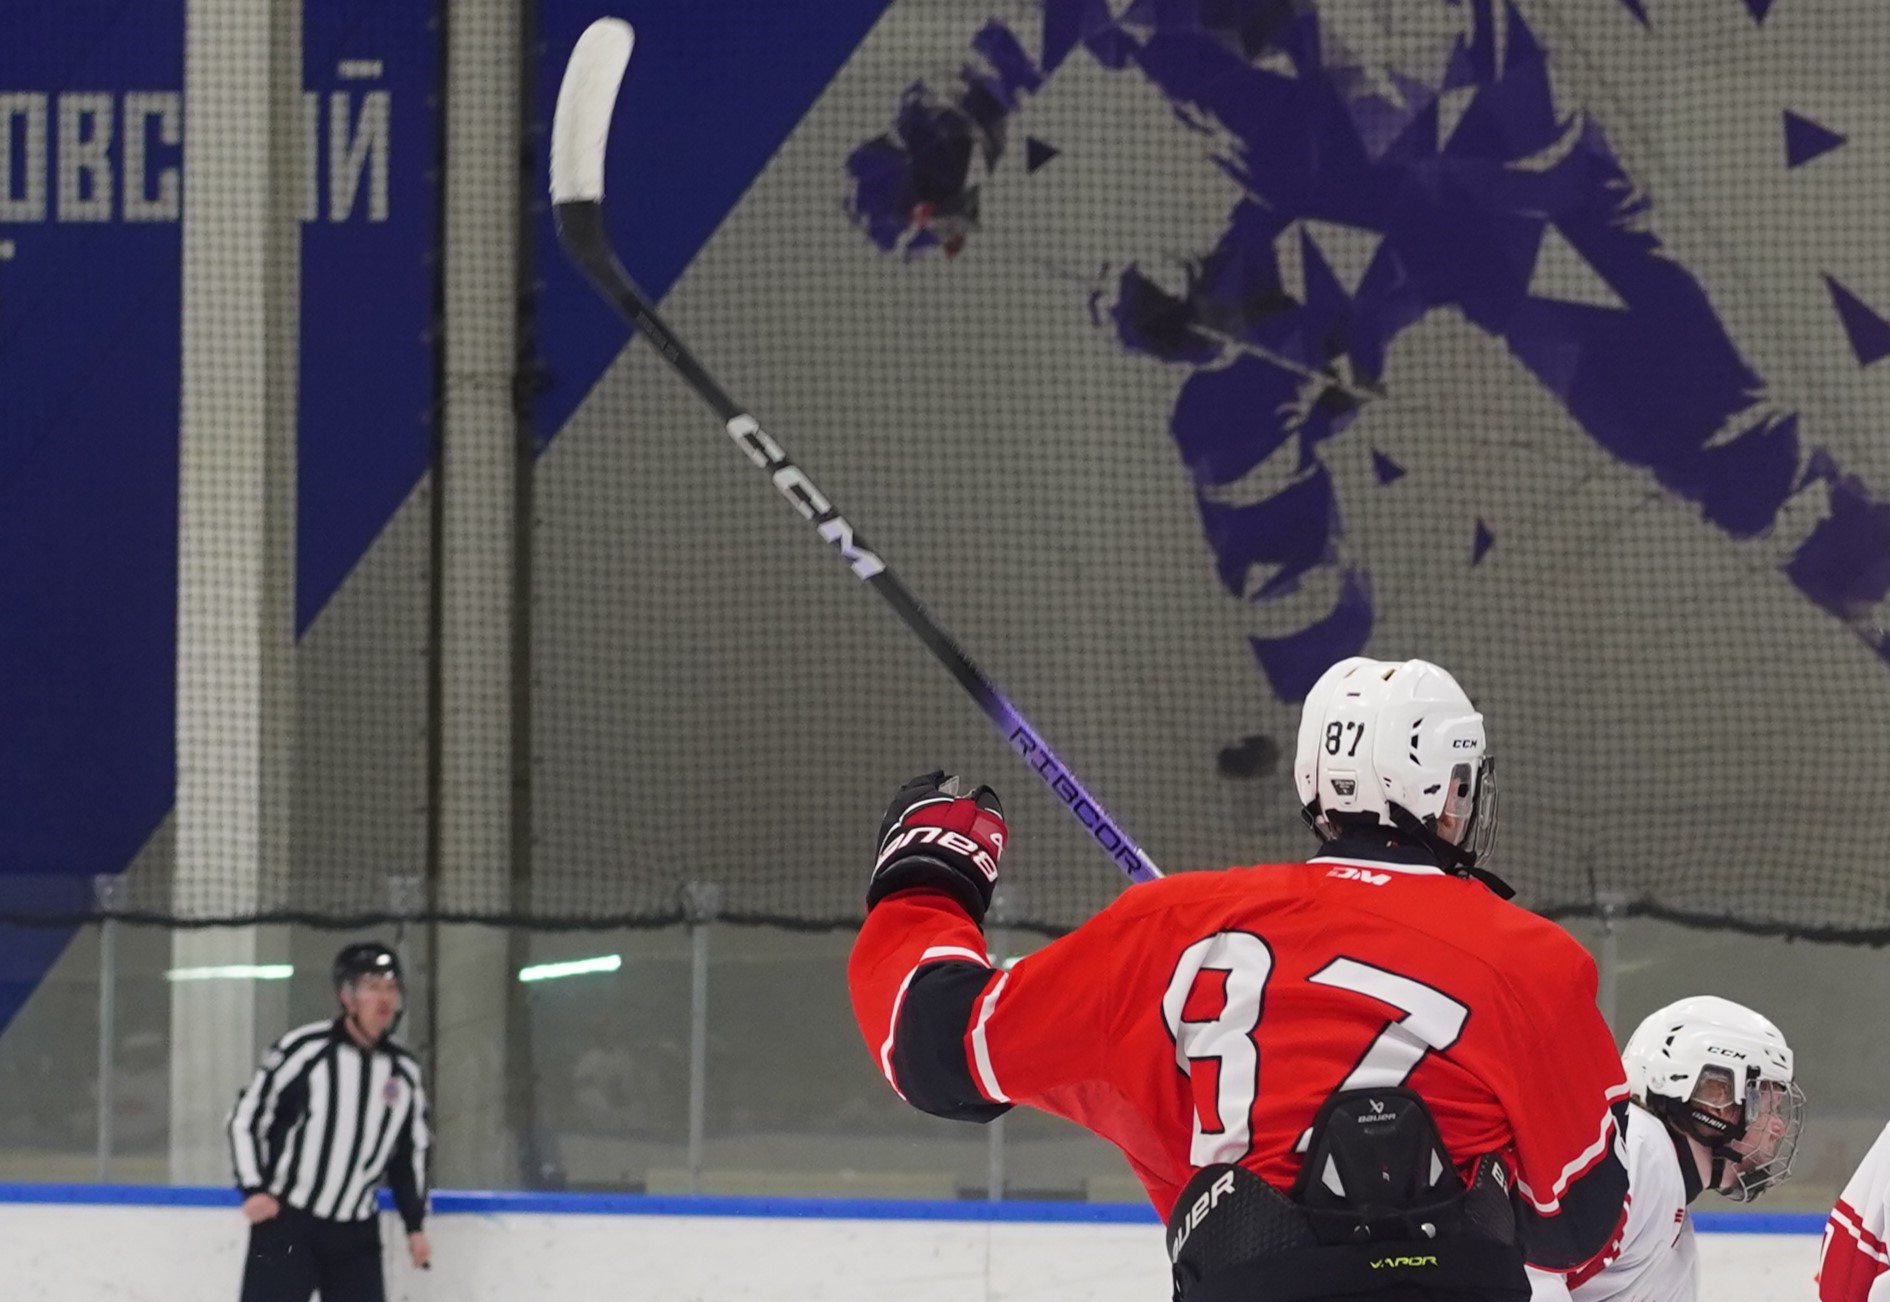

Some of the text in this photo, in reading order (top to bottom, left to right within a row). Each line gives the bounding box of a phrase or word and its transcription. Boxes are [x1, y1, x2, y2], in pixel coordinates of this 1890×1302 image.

[726, 413, 885, 580] CCM
[1325, 720, 1365, 757] 87
[1452, 738, 1478, 749] CCM
[1009, 726, 1142, 875] RIBCOR
[1160, 929, 1471, 1168] 87
[1707, 1046, 1747, 1060] CCM
[1370, 1255, 1439, 1270] VAPOR
